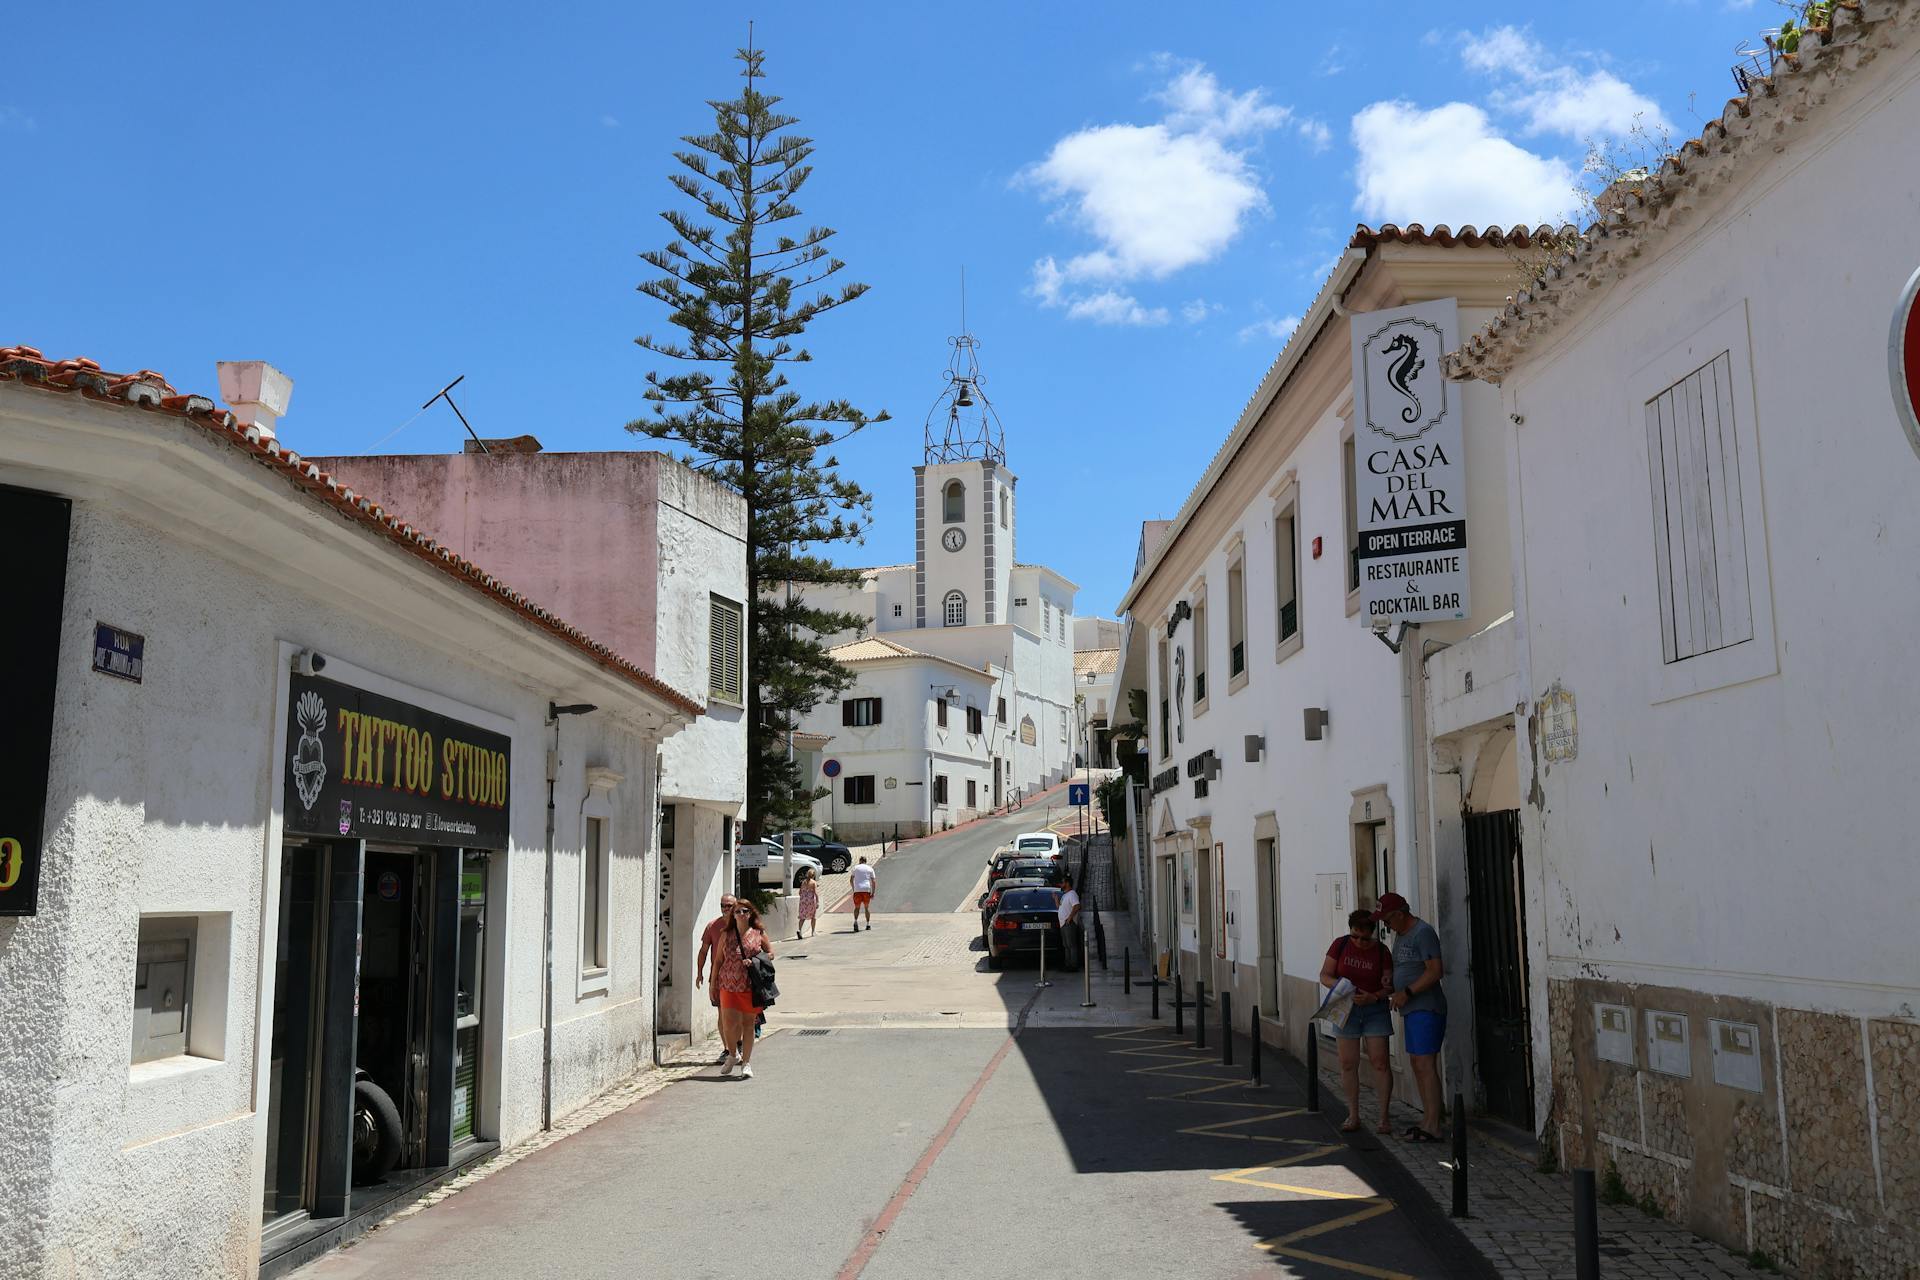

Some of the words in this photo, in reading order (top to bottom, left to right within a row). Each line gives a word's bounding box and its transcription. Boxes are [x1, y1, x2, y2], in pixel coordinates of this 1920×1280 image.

[1367, 443, 1451, 474] CASA
[1386, 472, 1432, 493] DEL
[1368, 489, 1454, 523] MAR
[1368, 533, 1399, 551] OPEN
[1401, 527, 1456, 547] TERRACE
[1367, 556, 1460, 580] RESTAURANTE
[1406, 579, 1419, 594] &
[1369, 596, 1429, 615] COCKTAIL
[1433, 593, 1460, 610] BAR
[338, 708, 434, 795] TATTOO
[442, 738, 507, 808] STUDIO
[367, 808, 384, 825] +351
[385, 810, 397, 826] 936
